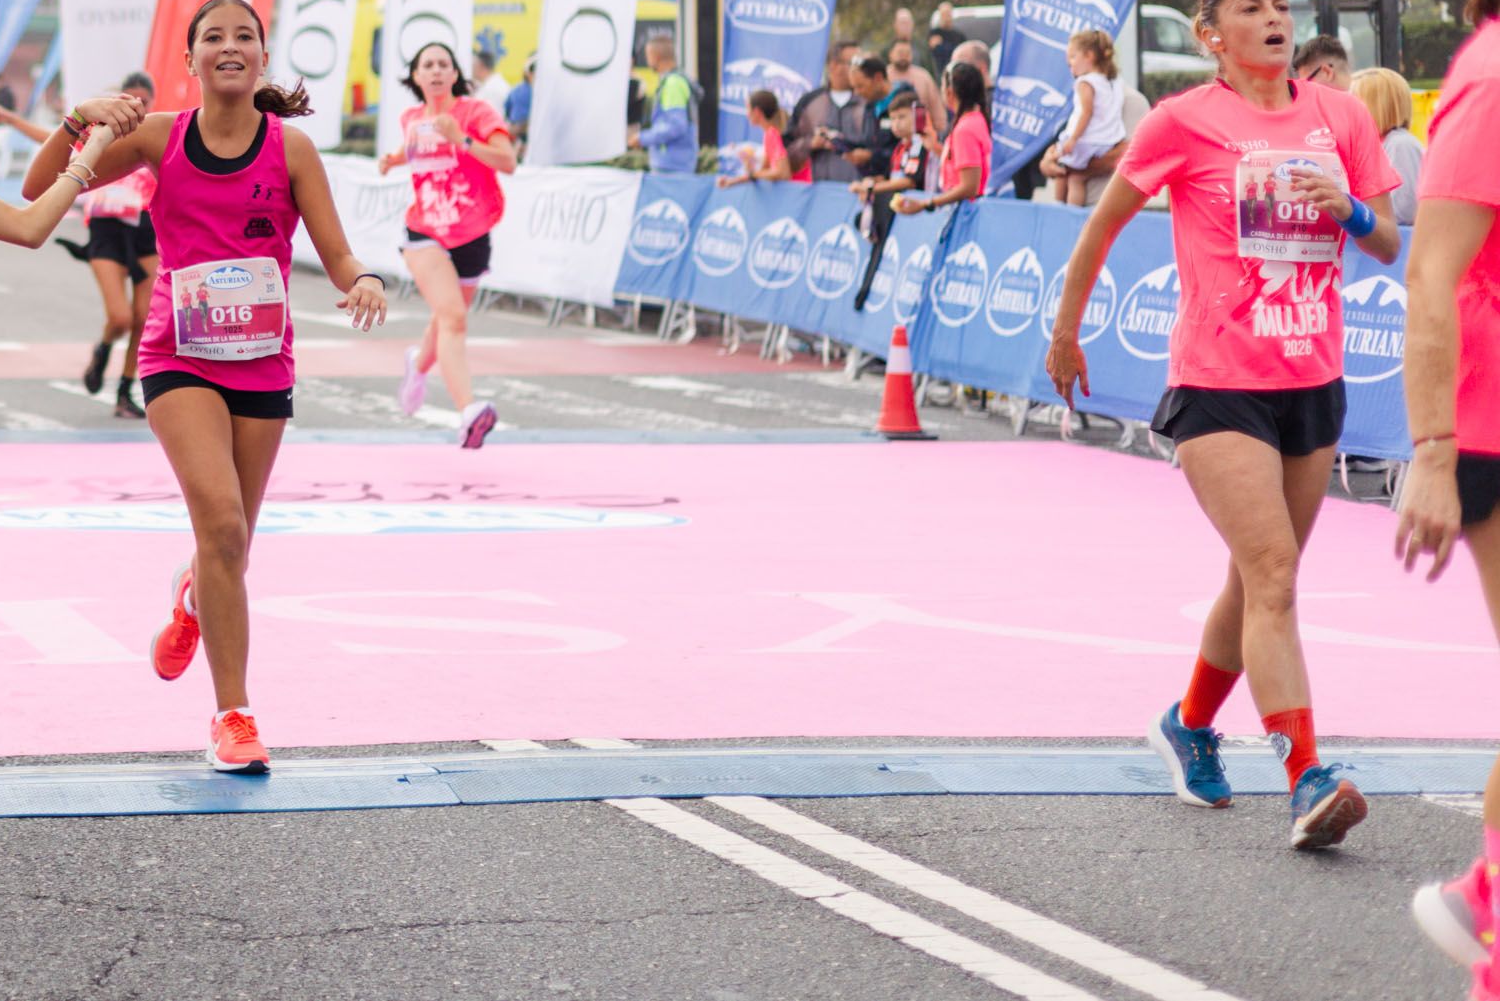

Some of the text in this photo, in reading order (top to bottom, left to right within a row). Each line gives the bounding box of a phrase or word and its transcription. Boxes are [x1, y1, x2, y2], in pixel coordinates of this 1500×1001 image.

[1277, 201, 1320, 221] 016
[211, 305, 253, 324] 016
[1252, 298, 1328, 338] MUJER
[1283, 338, 1313, 358] 2026
